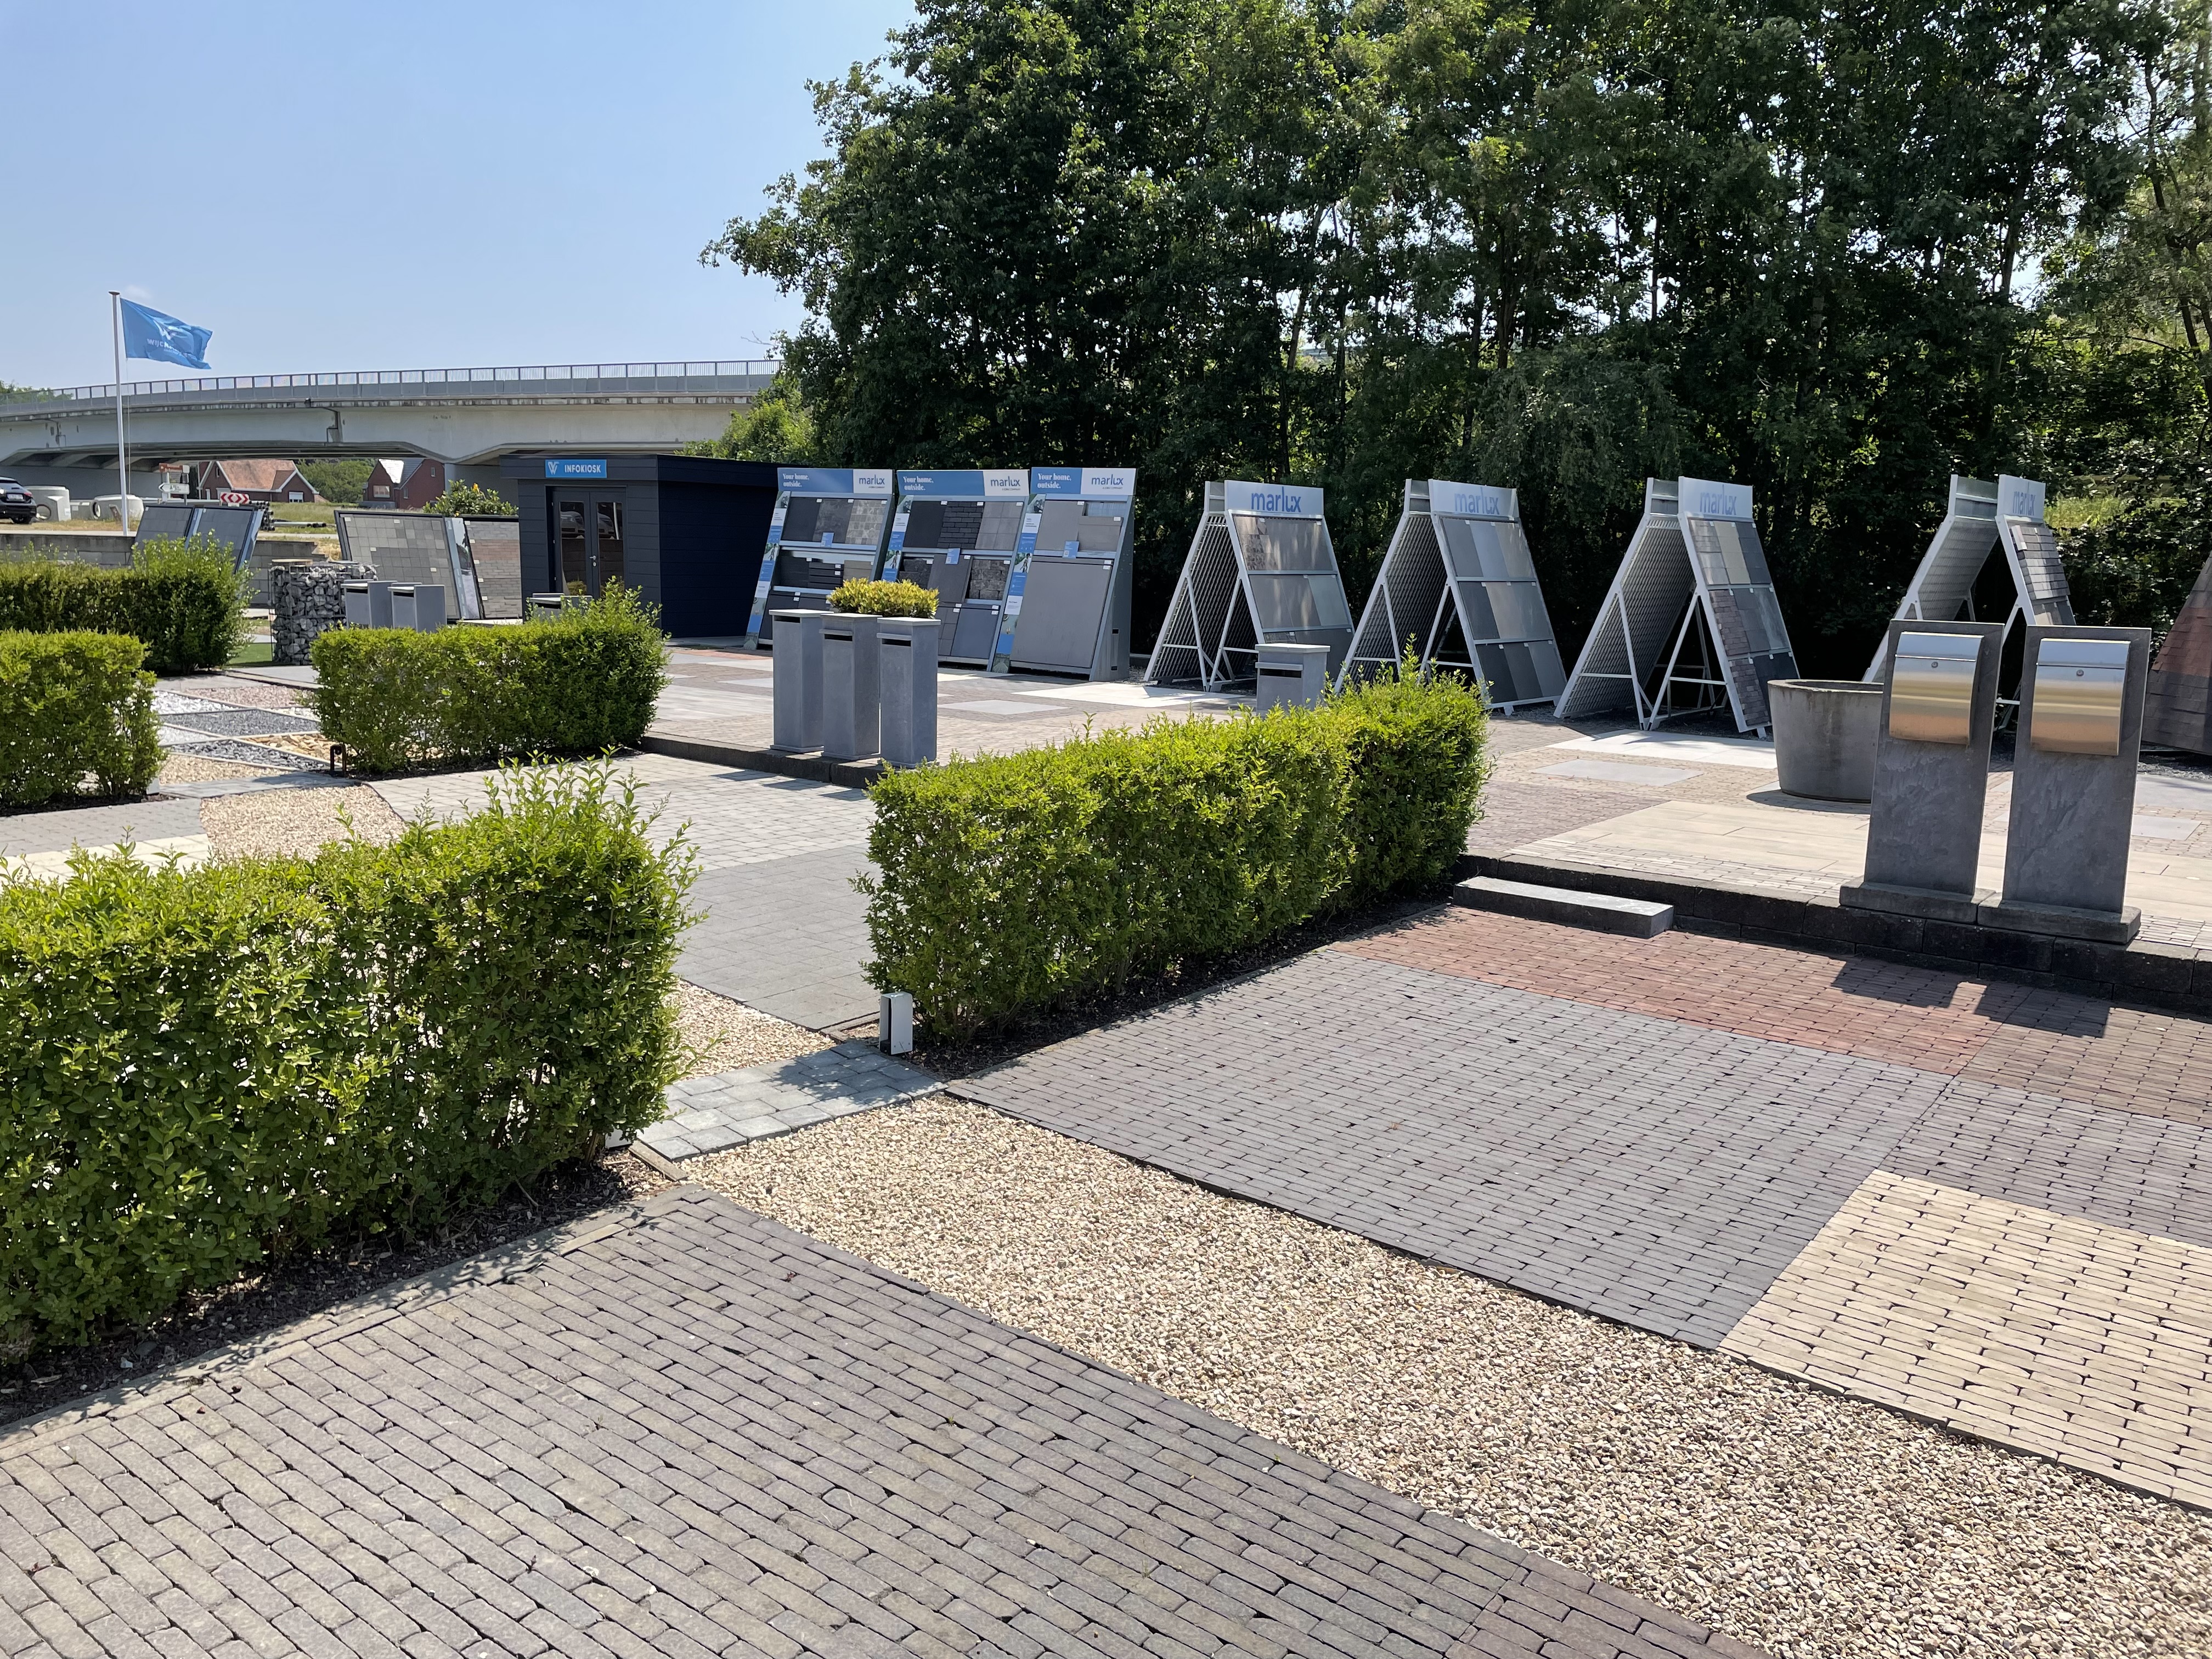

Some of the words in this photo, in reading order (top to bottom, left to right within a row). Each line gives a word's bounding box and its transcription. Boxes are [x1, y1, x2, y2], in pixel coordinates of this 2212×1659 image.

[565, 464, 601, 473] INFOKIOSK
[859, 474, 885, 485] marlux
[990, 475, 1020, 487] marlux
[1053, 472, 1071, 481] home,
[1091, 473, 1124, 486] marlux
[1037, 481, 1062, 489] outside.
[1251, 486, 1301, 513] marlux
[1454, 486, 1500, 515] marlux
[1700, 484, 1737, 516] marlux
